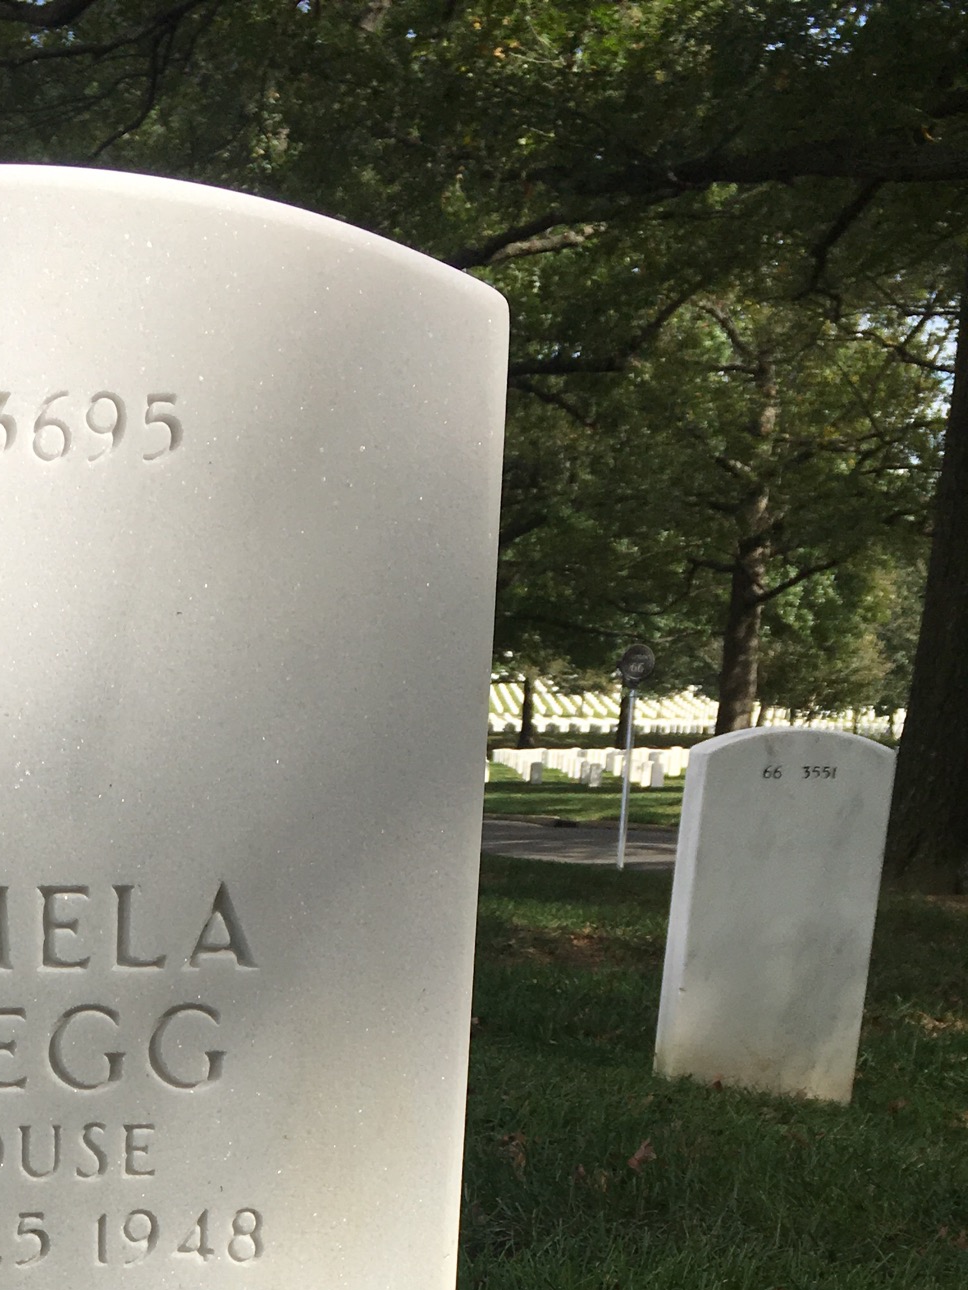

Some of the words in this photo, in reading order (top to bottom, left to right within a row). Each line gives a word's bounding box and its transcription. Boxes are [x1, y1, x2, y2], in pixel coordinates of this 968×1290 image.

[762, 765, 782, 779] 66
[802, 765, 838, 779] 3551
[94, 1207, 265, 1266] 1948
